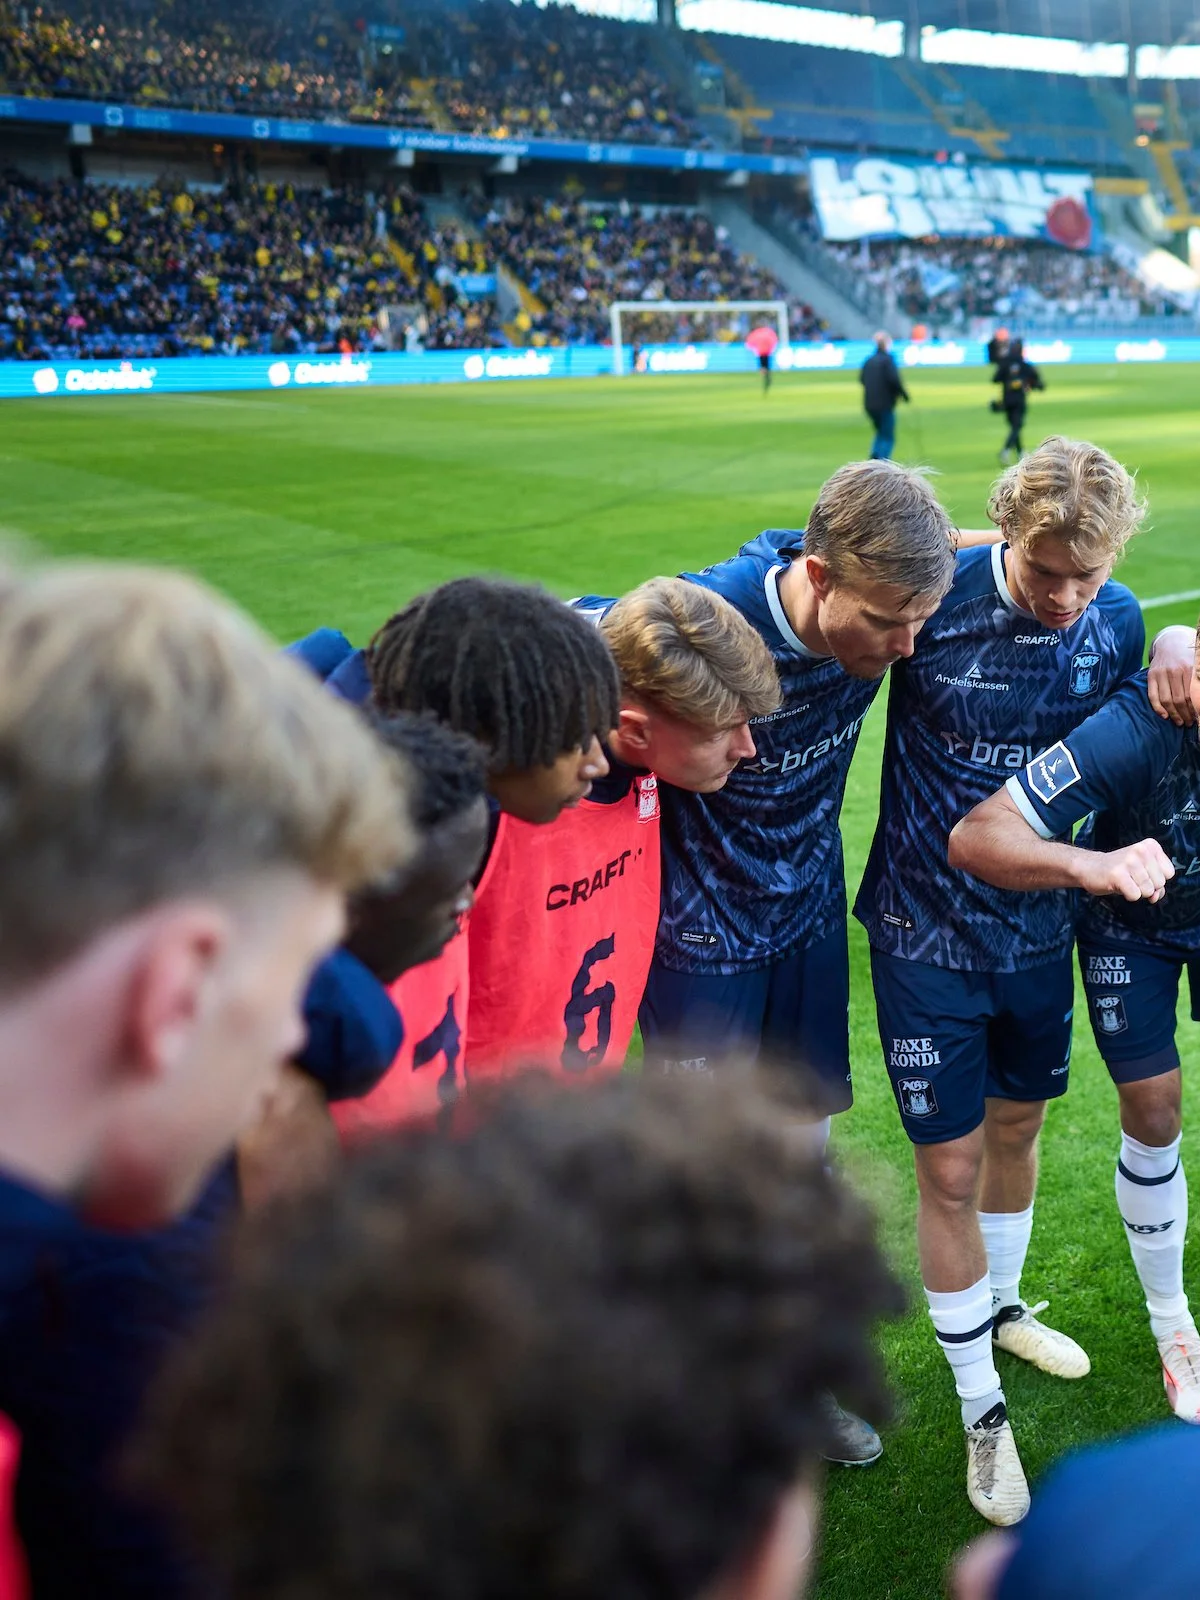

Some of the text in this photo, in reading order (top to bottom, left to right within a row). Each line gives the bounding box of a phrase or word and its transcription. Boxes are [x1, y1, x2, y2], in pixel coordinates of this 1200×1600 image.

[1014, 635, 1051, 645] CRAFT
[934, 673, 1010, 692] Andelskassen
[747, 703, 810, 725] delskassen
[781, 703, 871, 773] bravid
[970, 735, 1046, 768] brav
[546, 849, 631, 911] CRAFT
[1088, 956, 1126, 970] FAXE
[1086, 970, 1131, 984] KONDI
[560, 932, 616, 1074] 6
[893, 1038, 933, 1053] FAXE
[664, 1057, 706, 1075] FXE
[890, 1051, 941, 1068] KONDI
